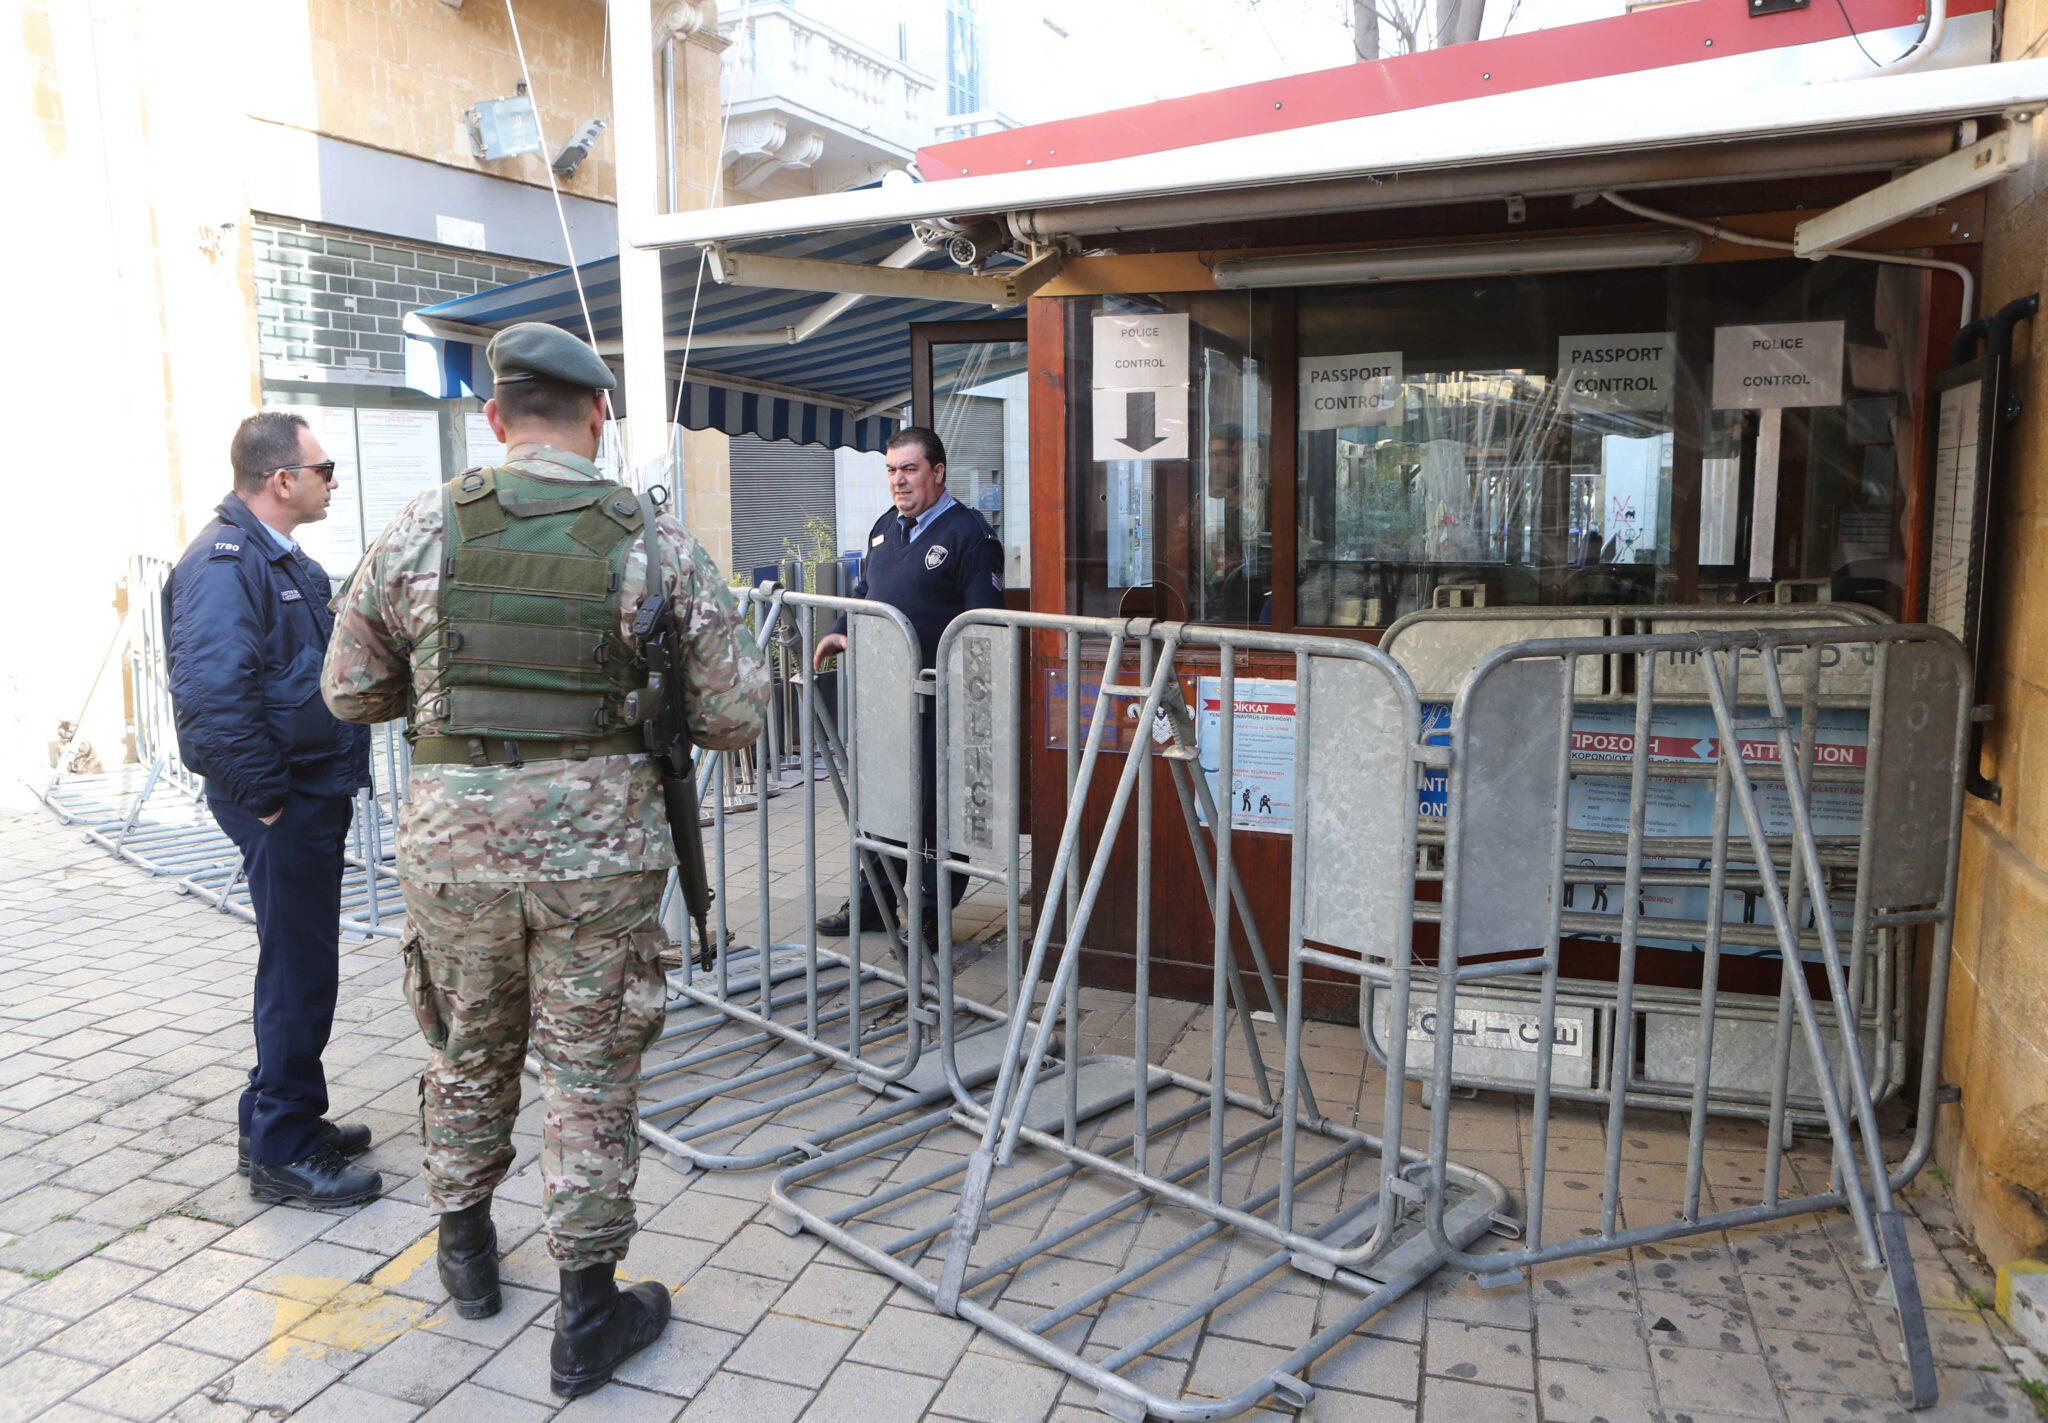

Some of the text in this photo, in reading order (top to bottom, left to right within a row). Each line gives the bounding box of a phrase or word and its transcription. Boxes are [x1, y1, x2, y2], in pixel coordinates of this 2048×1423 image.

[1121, 327, 1160, 338] POLICE
[1751, 337, 1805, 351] POLICE
[1114, 358, 1166, 369] CONTROL
[1570, 347, 1664, 364] PASSPORT
[1310, 366, 1392, 384] PASSPORT
[1742, 374, 1812, 387] CONTROL
[1573, 376, 1659, 393] CONTROL
[1314, 394, 1390, 411] CONTROL
[214, 542, 240, 562] 1780
[1571, 733, 1659, 753] ΠΡΟΣΟΗ
[1406, 1012, 1577, 1046] OLICE
